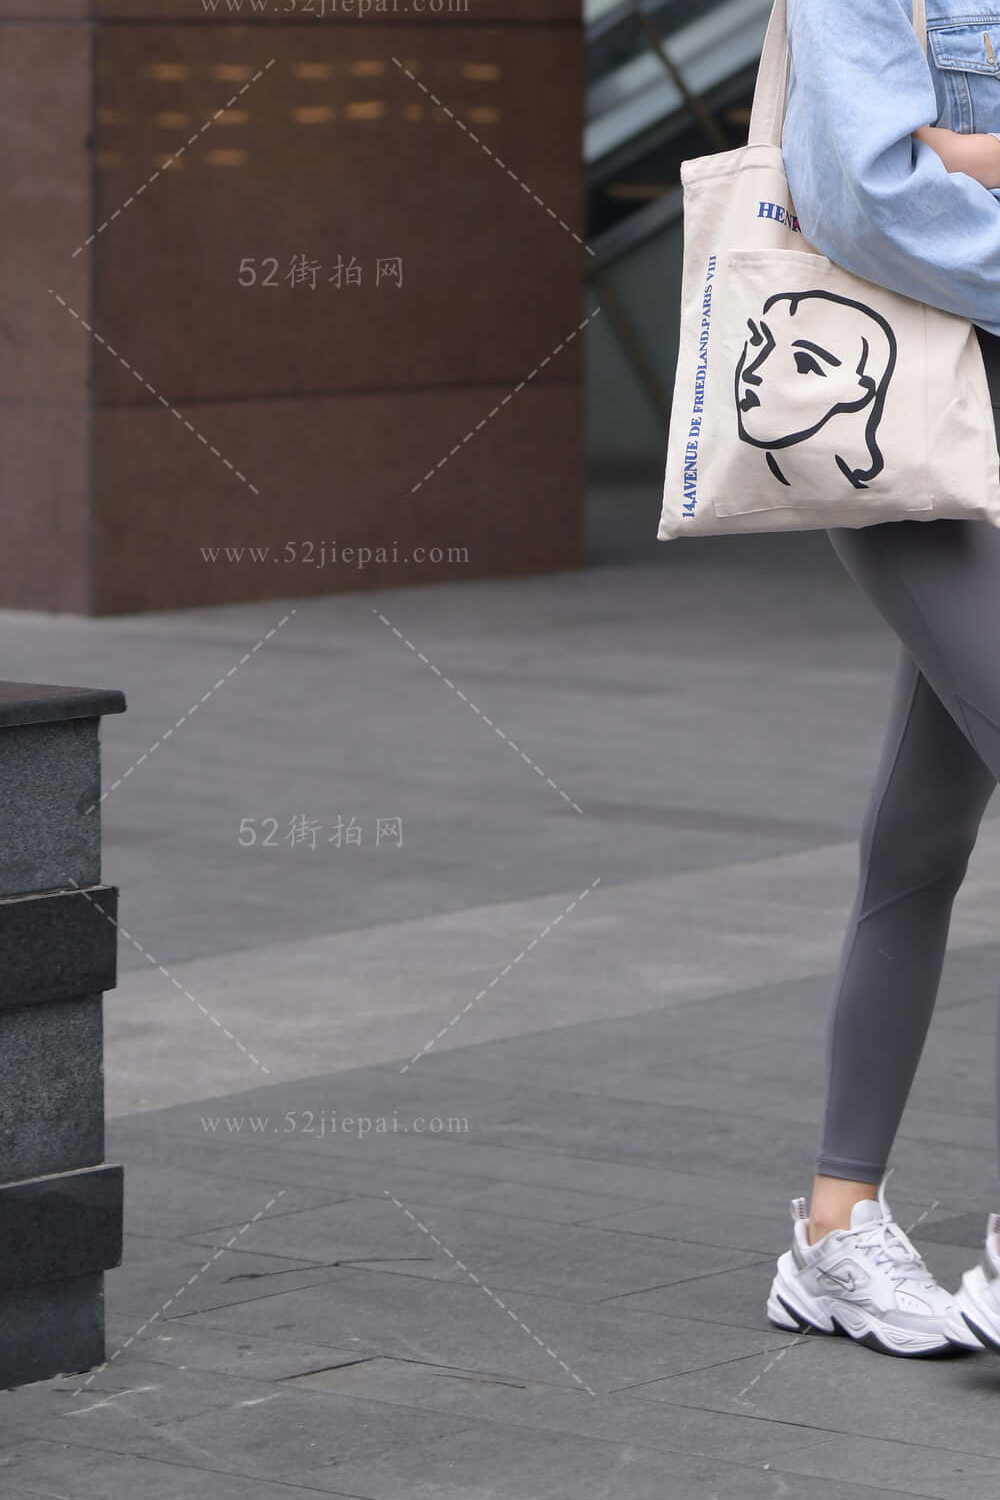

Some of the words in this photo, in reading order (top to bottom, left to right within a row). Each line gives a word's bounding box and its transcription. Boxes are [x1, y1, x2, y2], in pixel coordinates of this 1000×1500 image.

[706, 255, 717, 282] VIII
[689, 416, 702, 437] DE
[682, 440, 698, 518] 14,AVENUE
